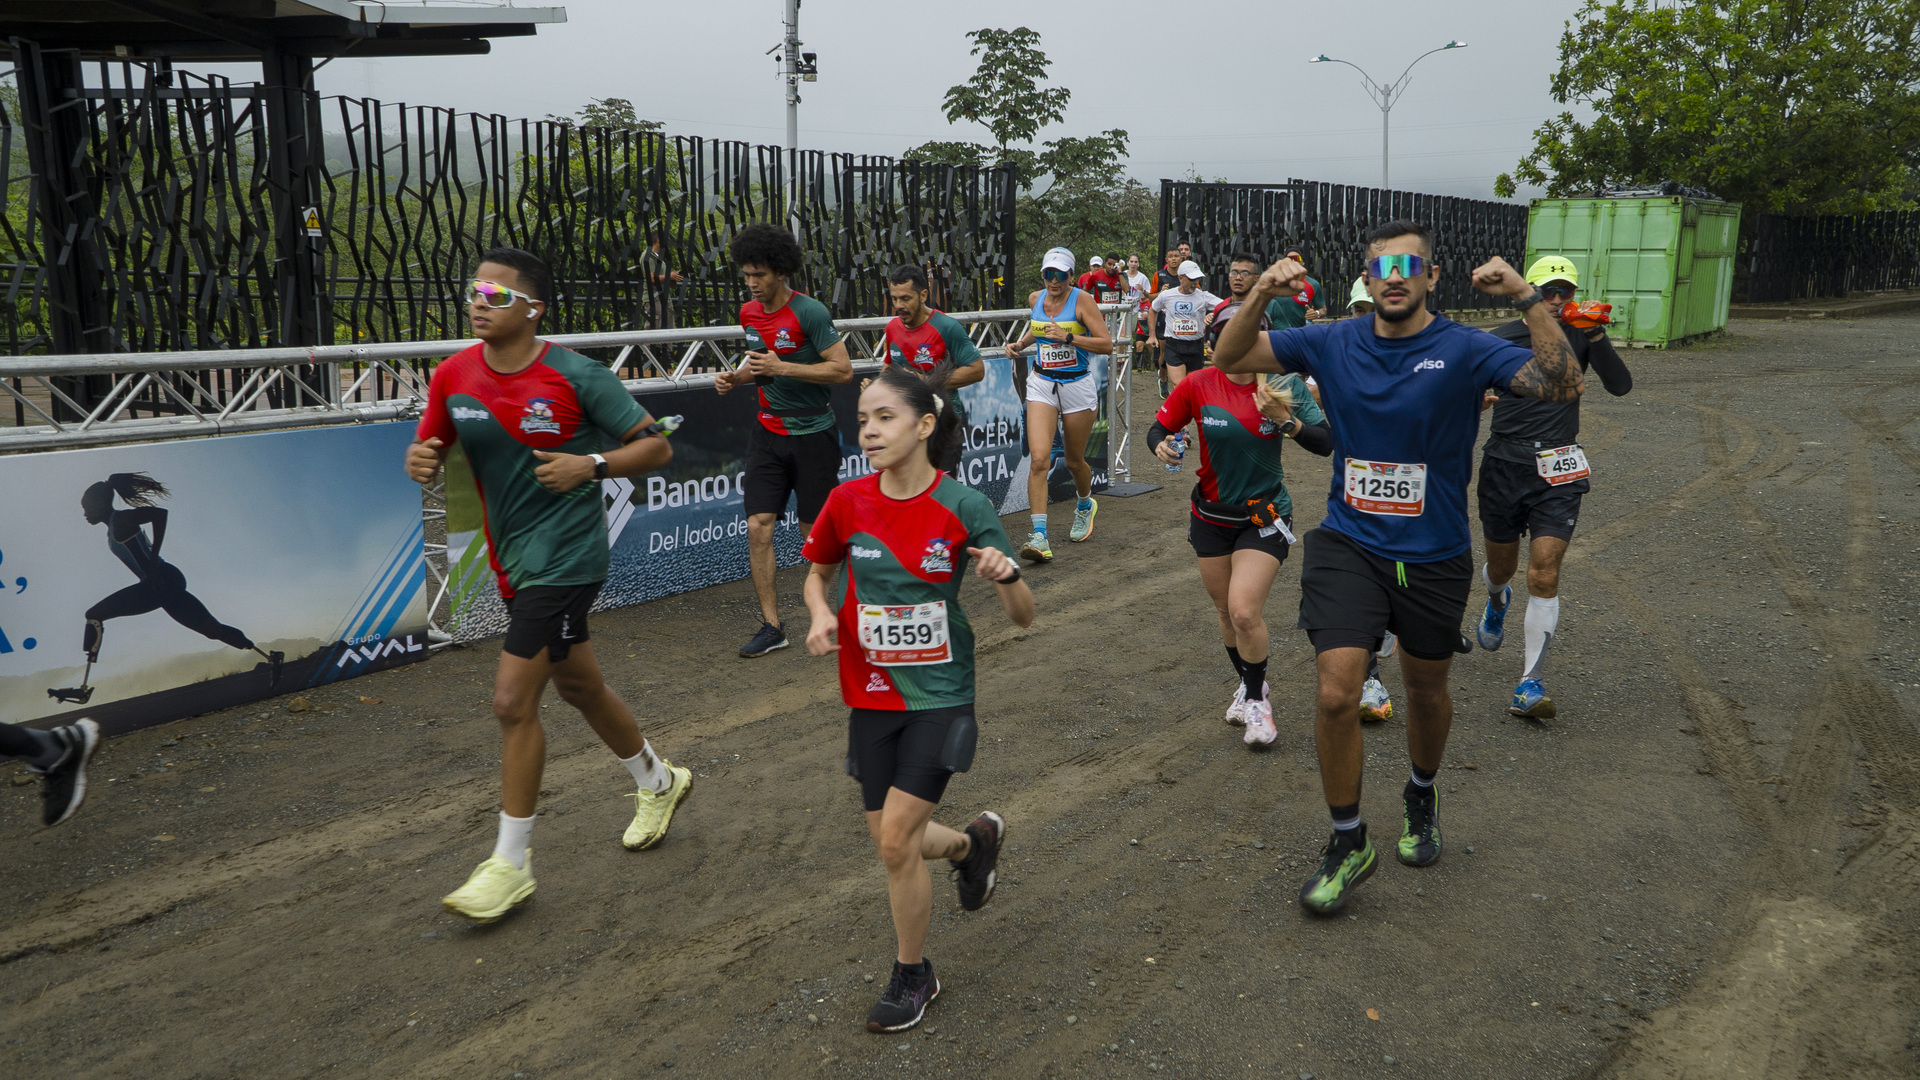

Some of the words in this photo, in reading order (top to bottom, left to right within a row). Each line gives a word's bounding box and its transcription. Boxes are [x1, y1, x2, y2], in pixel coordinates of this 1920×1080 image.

[1045, 350, 1070, 361] 1960
[962, 420, 1014, 452] ACER,
[956, 453, 1014, 486] ACTA.
[1552, 457, 1577, 473] 459
[647, 474, 730, 512] Banco
[1357, 477, 1410, 500] 1256
[649, 526, 680, 555] Del
[684, 519, 724, 547] lado
[347, 633, 381, 646] Grupo
[873, 623, 932, 646] 1559
[336, 634, 423, 668] AVAL
